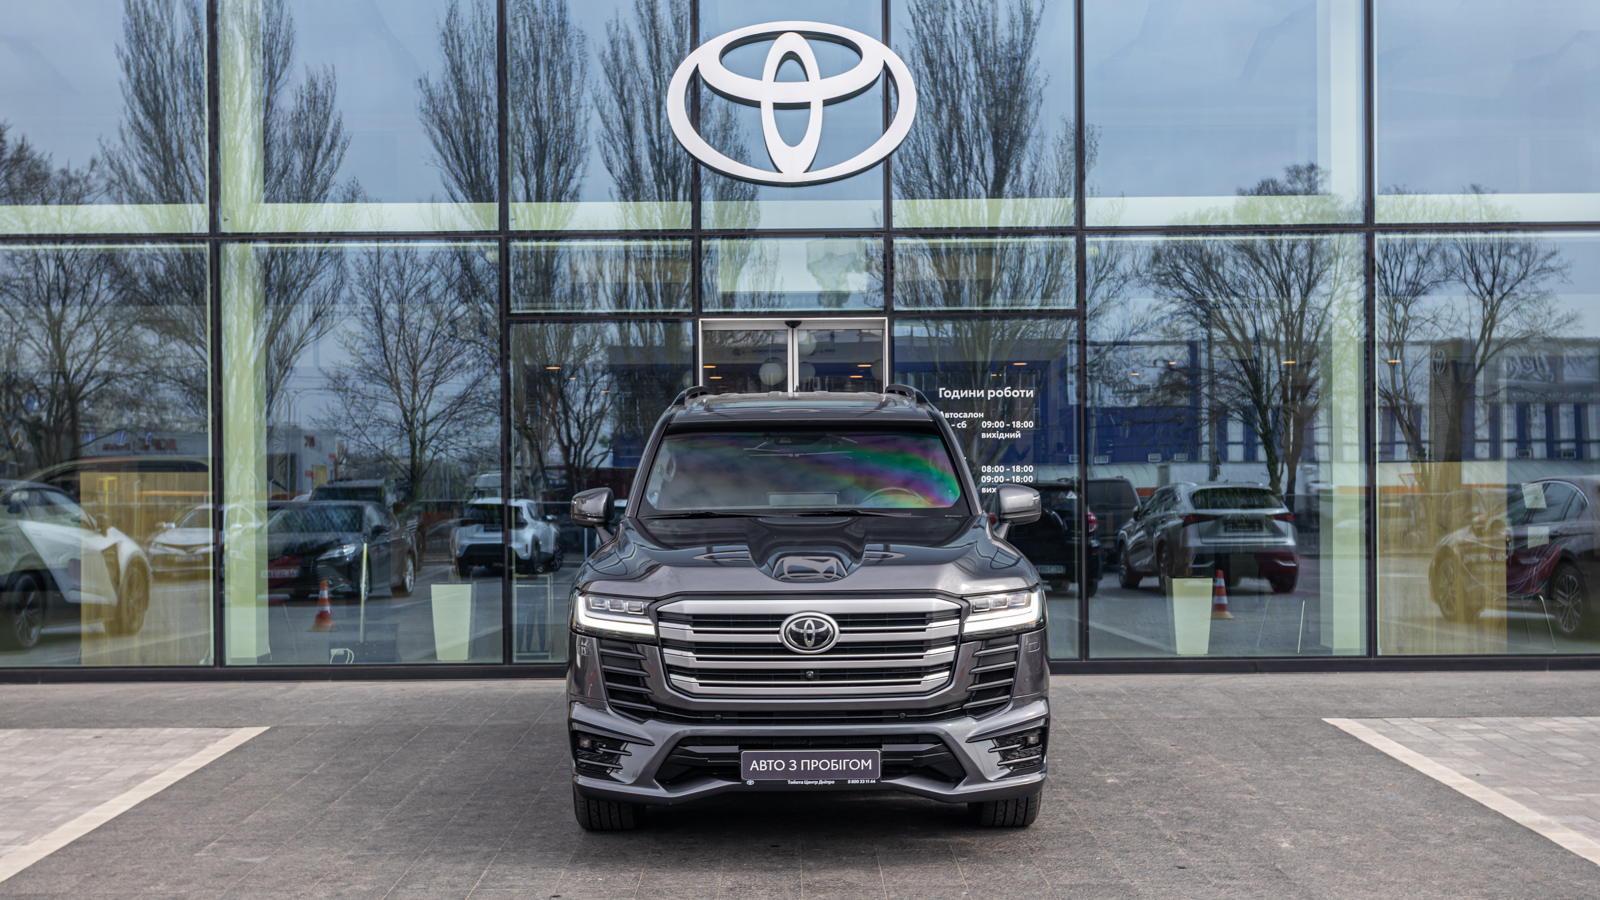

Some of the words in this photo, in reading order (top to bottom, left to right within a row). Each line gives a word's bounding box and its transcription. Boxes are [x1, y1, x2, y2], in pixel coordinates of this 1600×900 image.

[939, 387, 985, 400] Години
[987, 386, 1034, 401] роботи
[956, 420, 967, 429] сб
[981, 420, 1005, 429] 09:00
[1011, 420, 1034, 429] 18:00
[981, 431, 1021, 440] вихідний
[981, 465, 1005, 473] 08:00
[1011, 465, 1034, 473] 18:00
[981, 475, 1005, 483] 09:00
[1011, 475, 1034, 483] 18:00
[749, 759, 786, 771] АВТО
[800, 758, 872, 771] ПРОБІГОМ
